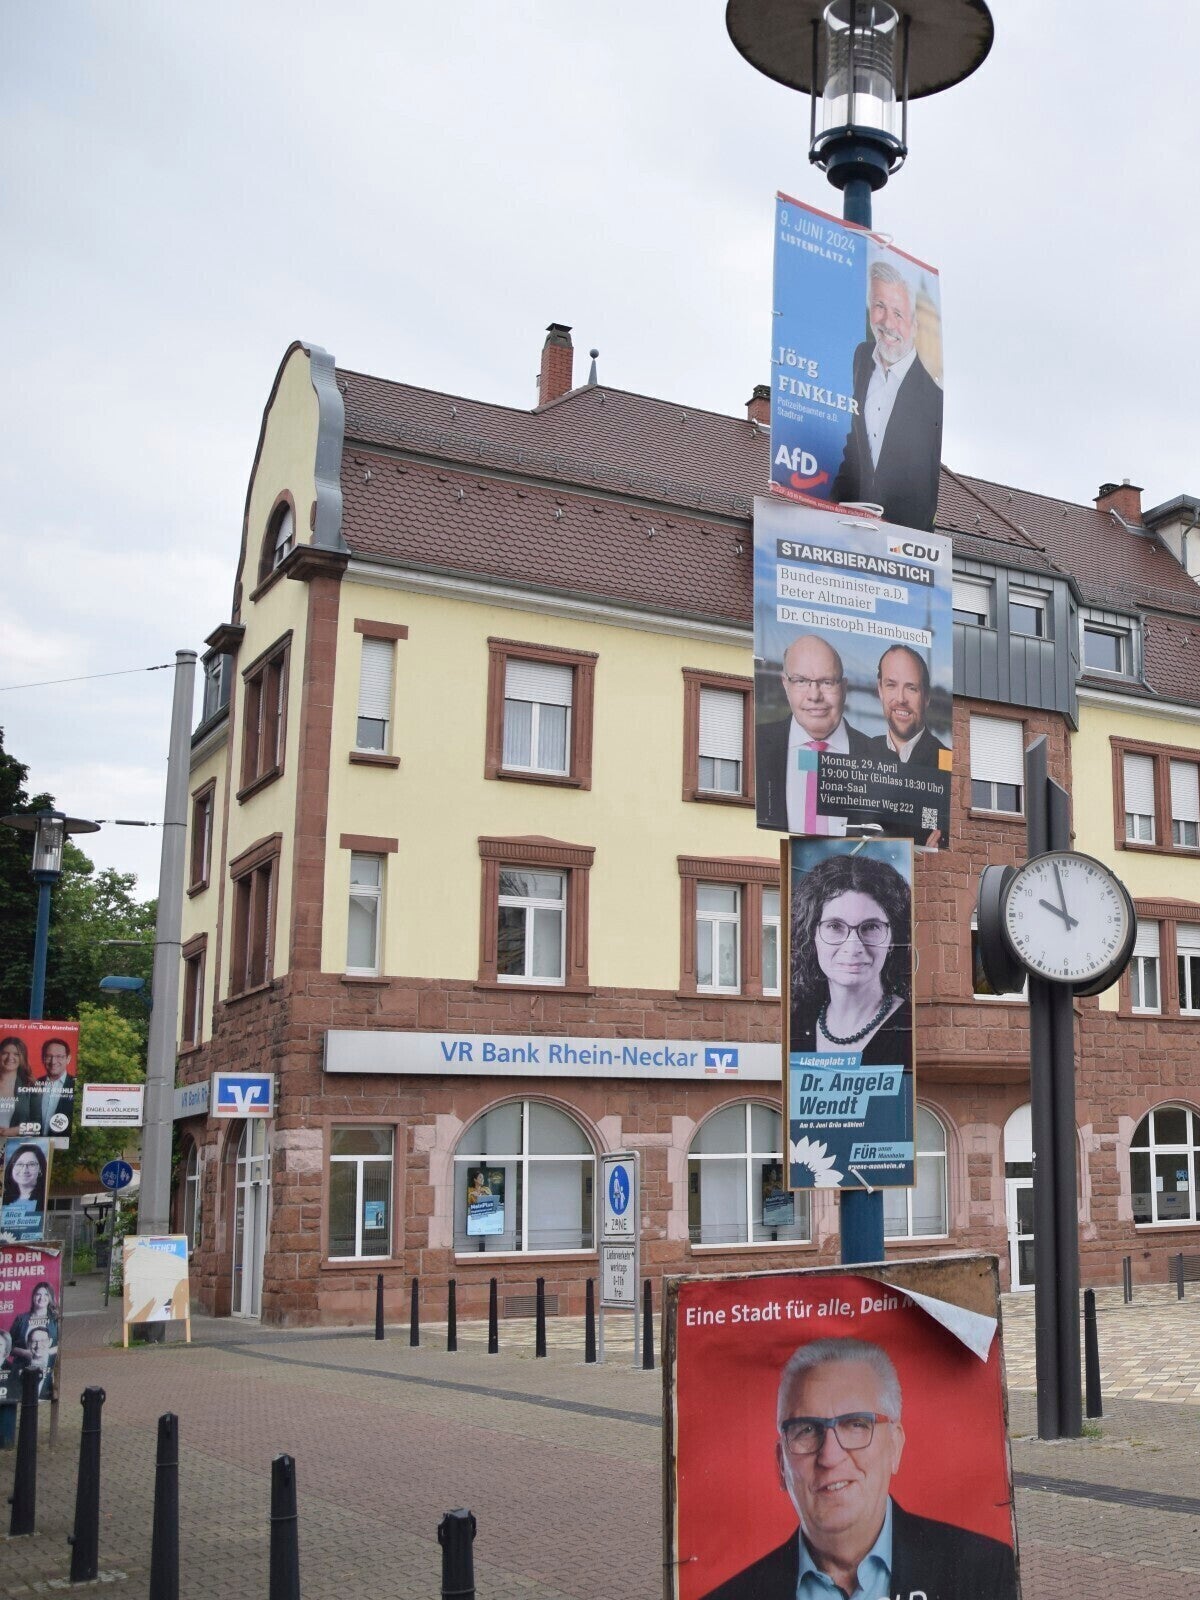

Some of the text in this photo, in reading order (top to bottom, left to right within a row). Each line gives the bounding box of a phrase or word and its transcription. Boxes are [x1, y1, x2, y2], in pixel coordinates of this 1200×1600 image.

[780, 210, 856, 253] 9. JUNI 2024
[781, 231, 844, 264] LISTENPLATZ
[778, 346, 819, 378] Jörg
[778, 374, 860, 416] FINKLER
[774, 444, 818, 476] AfD
[902, 542, 940, 562] CDU
[781, 541, 930, 583] STARKBIERANSTICH
[781, 567, 905, 601] Bundesminister a.D.
[781, 584, 872, 610] Peter Altmaier
[781, 607, 928, 644] Dr. Christoph Hambusch
[861, 760, 875, 770] 29.
[876, 762, 898, 774] April
[820, 780, 867, 794] Jona-Saal
[821, 767, 944, 795] 19:00 Uhr (Einlass 18:30 Uhr)
[820, 793, 914, 814] Viernheimer Weg 222
[1060, 870, 1070, 878] 12
[1100, 892, 1105, 900] 2
[1018, 912, 1024, 920] 9
[1108, 916, 1112, 924] 3
[1024, 934, 1030, 942] 8
[1064, 958, 1069, 966] 6
[1087, 952, 1091, 960] 5
[440, 1041, 698, 1068] VR Bank Rhein-Neckar
[800, 1057, 856, 1068] Listenplatz 13
[800, 1072, 894, 1096] Dr. Angela
[800, 1096, 858, 1116] Wendt
[19, 1122, 42, 1132] SPD
[854, 1144, 877, 1160] FÜR
[16, 1252, 42, 1263] DEN
[606, 1250, 630, 1260] Lieferverkehr
[0, 1265, 45, 1278] HEIMER
[610, 1262, 628, 1275] werktags
[614, 1287, 624, 1298] frei
[686, 1308, 726, 1326] Eine
[731, 1304, 782, 1323] Stadt
[786, 1300, 812, 1318] für
[817, 1298, 856, 1318] alle,
[861, 1294, 898, 1314] Dein
